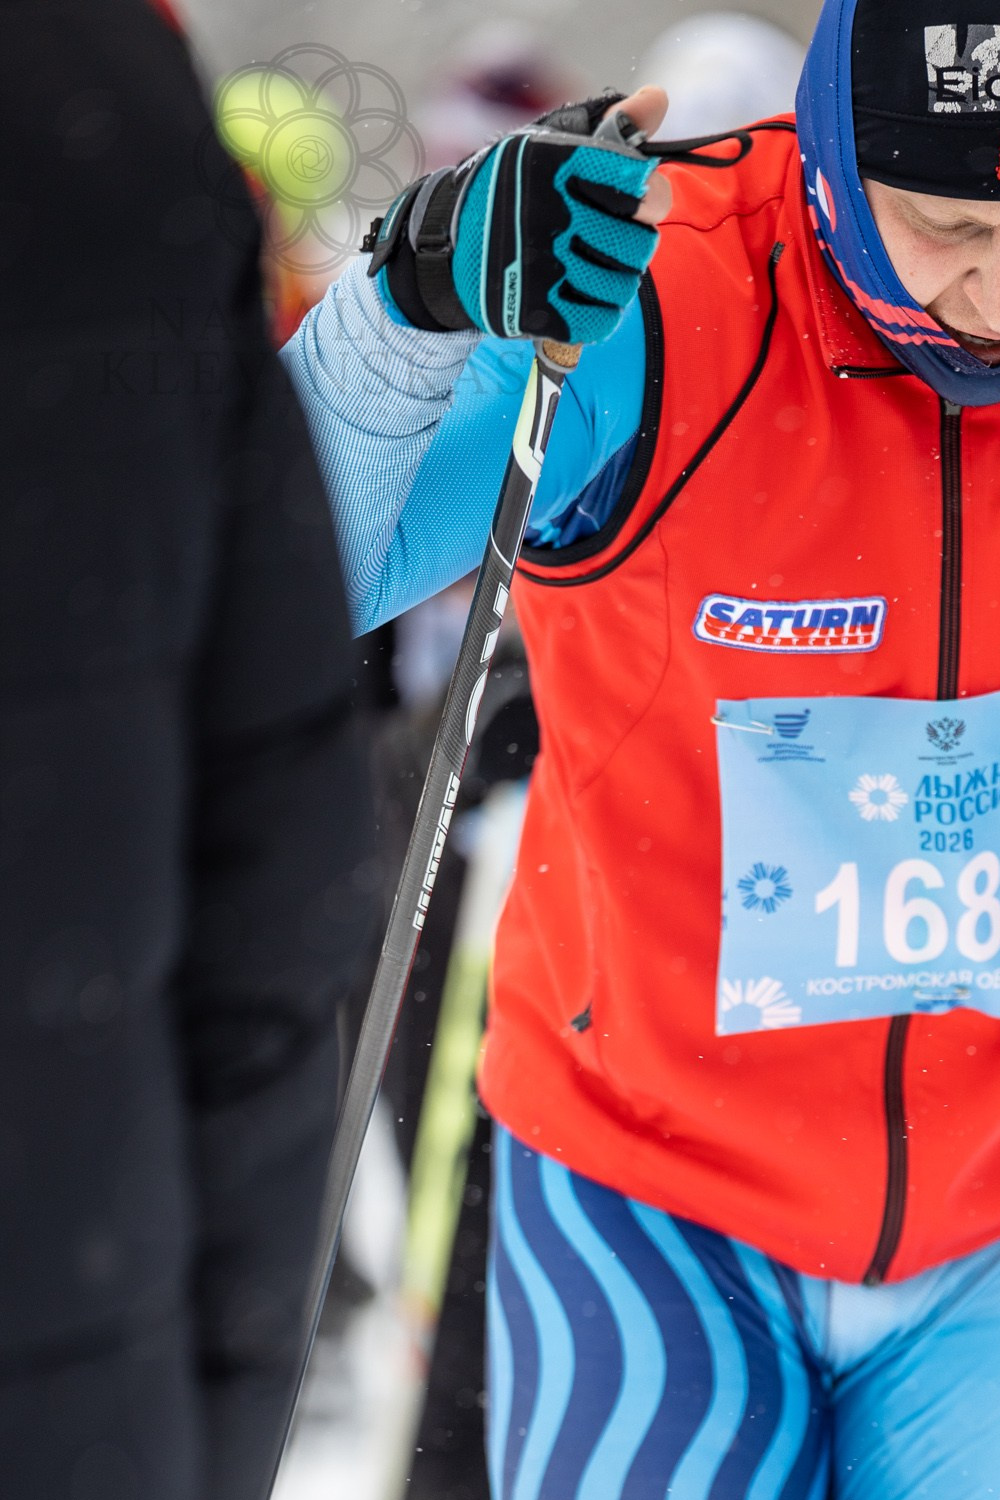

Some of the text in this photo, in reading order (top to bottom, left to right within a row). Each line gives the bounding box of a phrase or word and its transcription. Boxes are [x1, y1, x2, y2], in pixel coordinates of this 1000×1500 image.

[705, 602, 881, 637] SATURN
[919, 828, 974, 853] 2026
[806, 968, 974, 997] КОСТРОМСКАЯ
